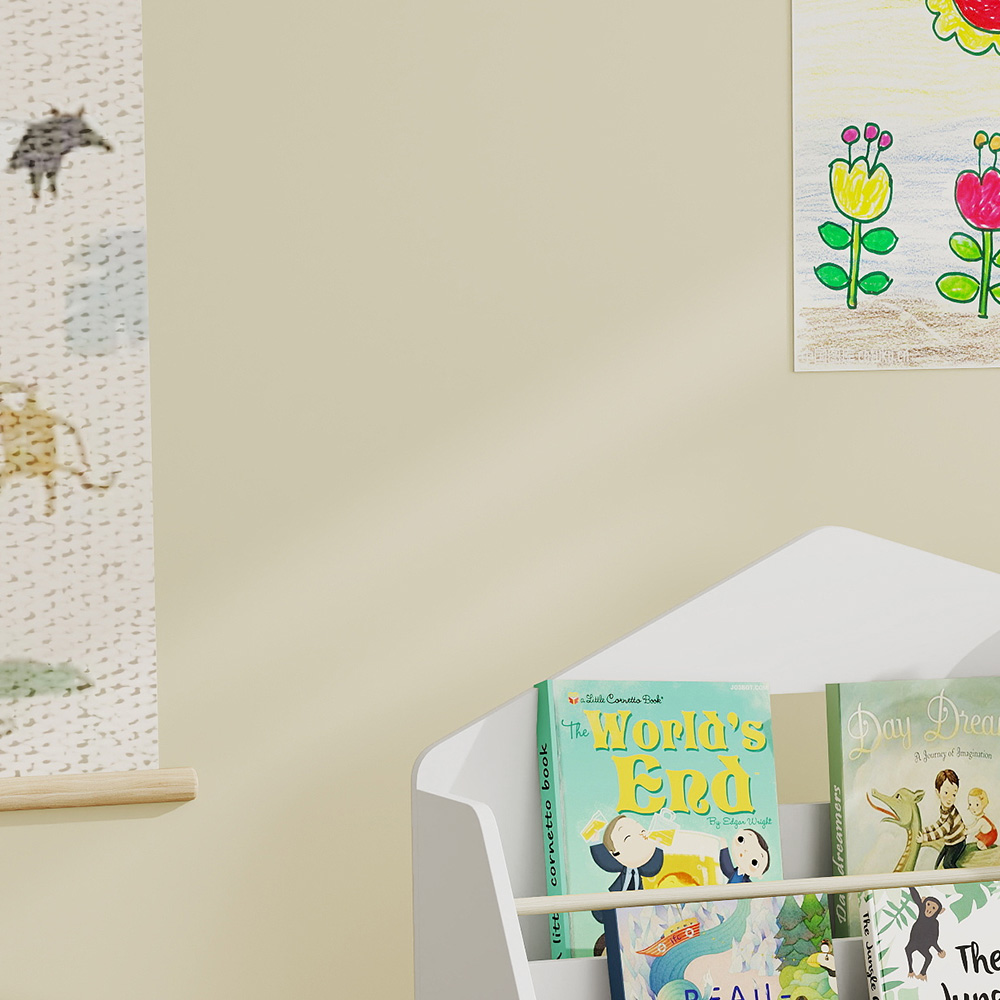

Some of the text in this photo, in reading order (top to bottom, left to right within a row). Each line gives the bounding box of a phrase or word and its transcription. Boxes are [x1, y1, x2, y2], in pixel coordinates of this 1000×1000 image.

[606, 693, 641, 704] Cornetto
[561, 709, 767, 753] The World's
[847, 703, 912, 761] Day
[539, 743, 550, 791] book
[611, 754, 756, 815] End
[545, 800, 557, 887] cornetto
[707, 816, 773, 830] By Edgar Wright
[832, 784, 846, 924] Da dreamers
[552, 912, 561, 944] litt
[862, 912, 871, 937] The
[865, 941, 877, 992] Jungle
